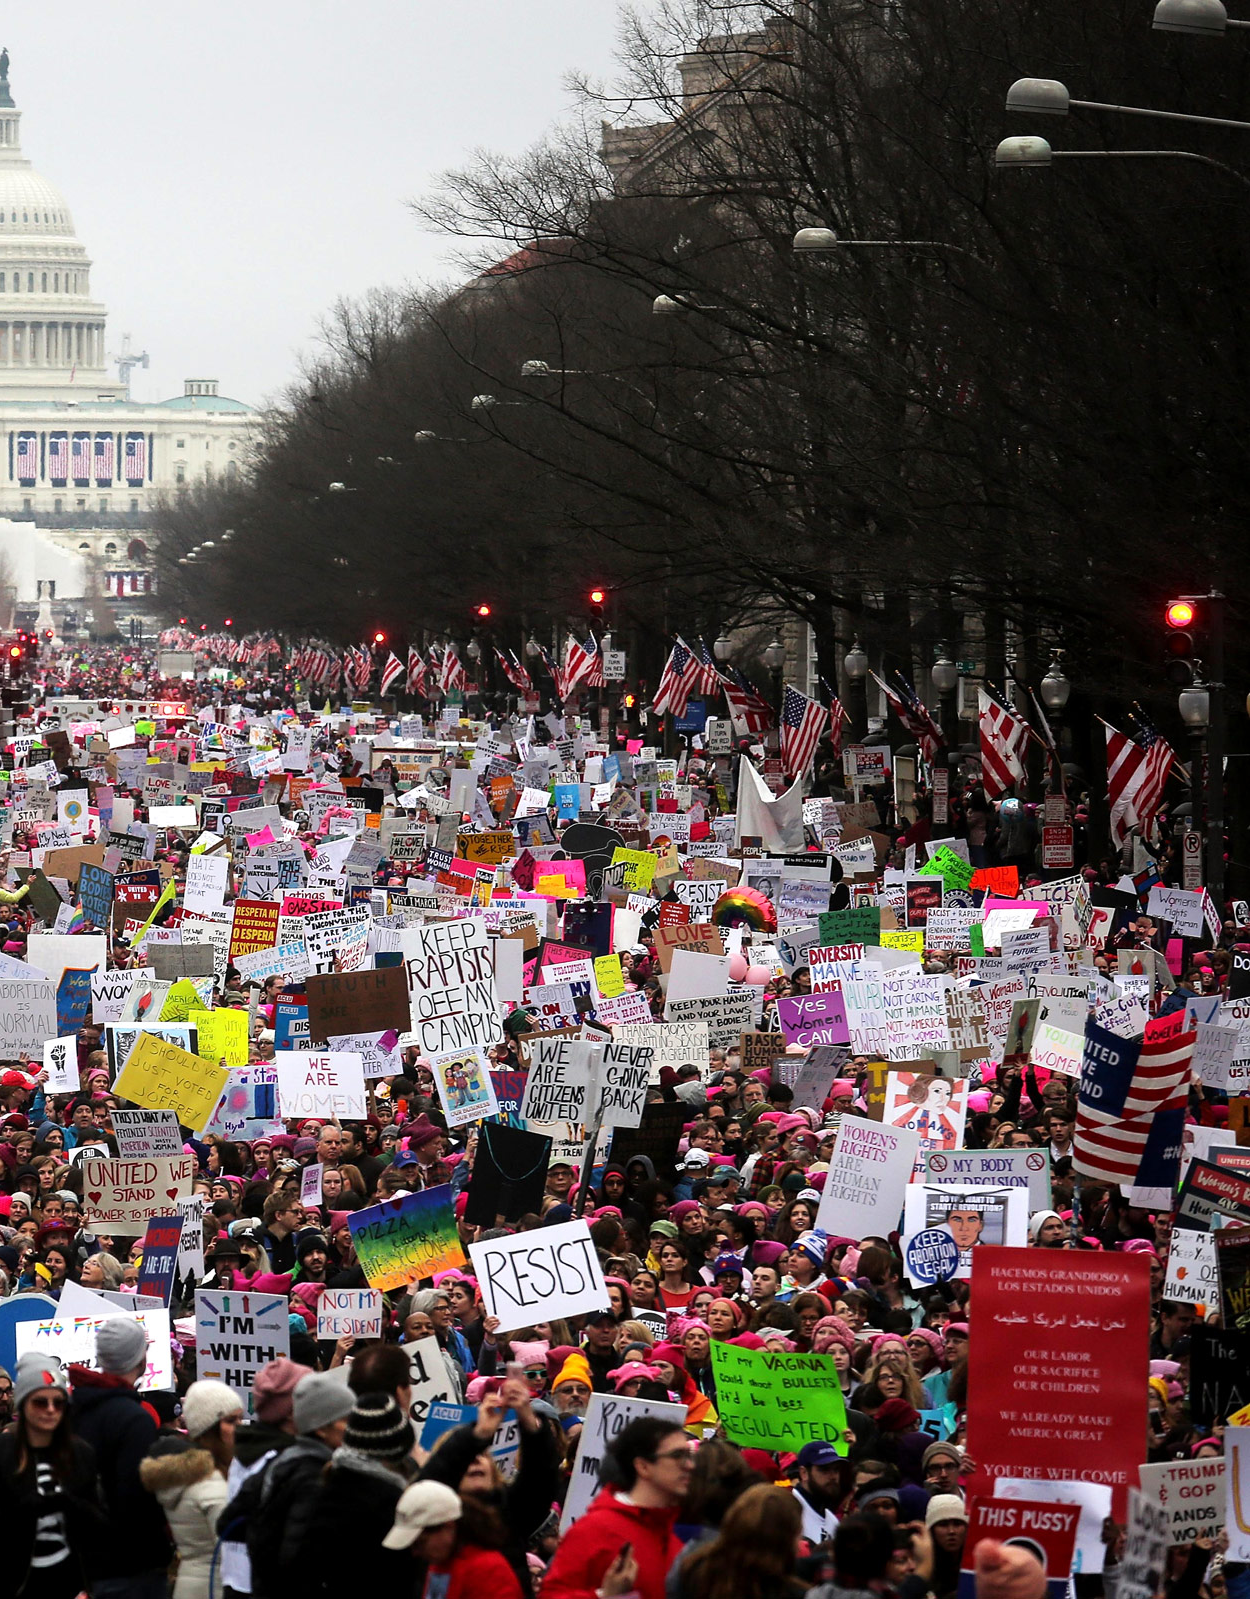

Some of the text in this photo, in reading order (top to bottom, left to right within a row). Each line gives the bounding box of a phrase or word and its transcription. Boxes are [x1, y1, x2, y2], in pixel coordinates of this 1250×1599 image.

[468, 834, 513, 844] TOGETHER
[476, 844, 514, 856] WE RISE
[677, 883, 724, 902] RESIST
[333, 910, 346, 918] FOR
[350, 906, 366, 915] THE
[421, 923, 475, 952] KEEP
[407, 946, 492, 991] RAPISTS
[418, 980, 496, 1018] OFF MY
[791, 999, 827, 1014] Yes
[784, 1013, 842, 1031] Women
[421, 1012, 500, 1052] CAMPUS
[797, 1028, 832, 1046] CAN
[539, 1041, 572, 1064] WE
[602, 1045, 653, 1068] NEVER
[309, 1058, 331, 1071] WE
[532, 1064, 565, 1083] ARE
[131, 1058, 212, 1100] JUST VOTED
[305, 1073, 338, 1086] ARE
[158, 1082, 179, 1098] FOR
[134, 1088, 201, 1121] JOFFREY
[279, 1093, 365, 1116] WOMEN
[601, 1088, 642, 1114] BACK
[525, 1103, 578, 1121] UNITED
[843, 1124, 897, 1149] WOMEN'S
[840, 1141, 888, 1164] RIGHTS
[169, 1161, 191, 1179] WE
[836, 1159, 863, 1171] ARE
[953, 1158, 1014, 1172] MY BODY
[832, 1170, 882, 1191] HUMAN
[113, 1189, 155, 1201] STAND
[830, 1182, 879, 1206] RIGHTS
[86, 1207, 177, 1222] POWER TO THE PEO
[914, 1231, 946, 1249] KEEP
[908, 1247, 956, 1266] ABORTION
[484, 1239, 598, 1314] RESIST
[915, 1262, 953, 1279] LEGAL
[991, 1267, 1047, 1279] HACEMOS
[1049, 1269, 1118, 1281] GRANDIOSO
[998, 1281, 1121, 1295] LOS ESTADOS UNIDOS
[323, 1291, 352, 1310] NOT
[220, 1314, 254, 1335] I'M
[319, 1316, 380, 1337] PRESIDENT
[210, 1343, 274, 1363] WITH
[1024, 1349, 1091, 1362] OUR LABOR
[762, 1356, 826, 1371] VAGINA
[1014, 1365, 1100, 1377] OUR SACRIFICE
[225, 1369, 256, 1387] HE
[782, 1378, 836, 1388] BULLETS
[1013, 1380, 1100, 1393] OUR CHILDREN
[750, 1393, 765, 1406] be
[720, 1412, 839, 1442] REGULATED
[1000, 1410, 1113, 1426] WE ALREADY MAKE
[1008, 1427, 1103, 1440] AMERICA GREAT
[1047, 1467, 1127, 1483] WELCOME
[1168, 1463, 1226, 1481] TRUMP
[1179, 1484, 1216, 1499] GOP
[978, 1506, 1074, 1532] THIS PUSSY
